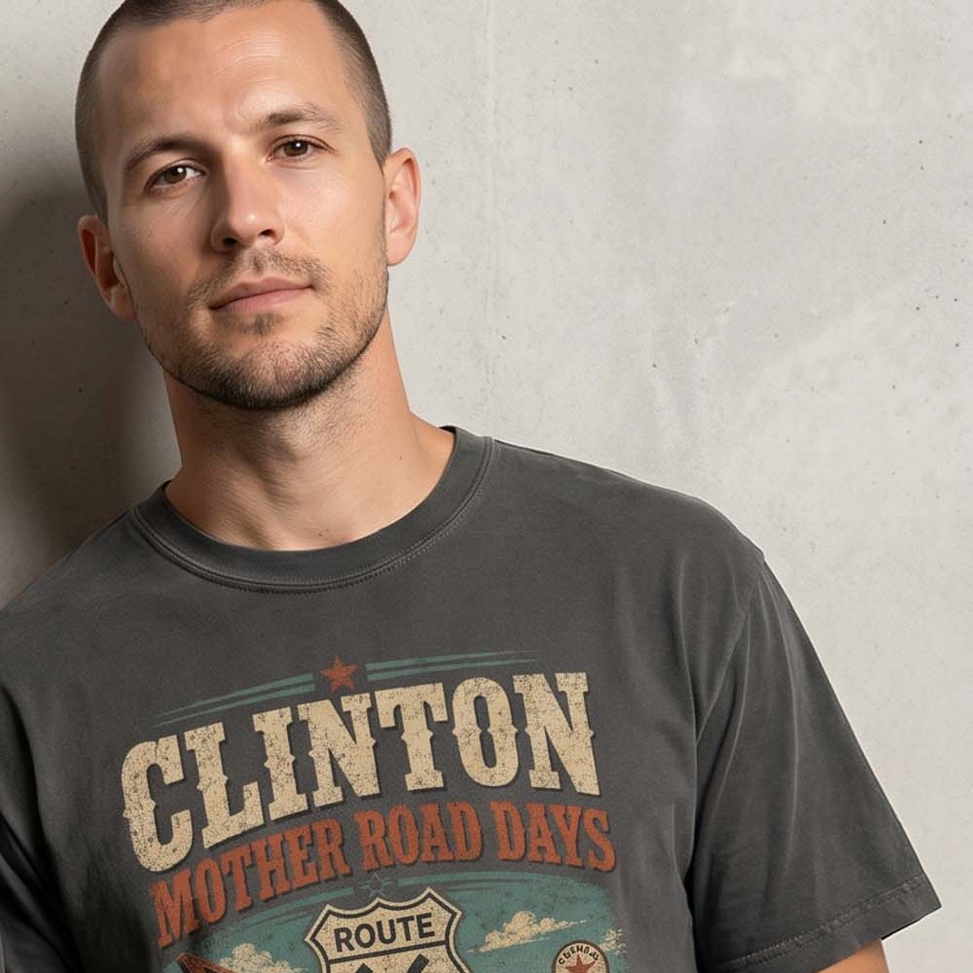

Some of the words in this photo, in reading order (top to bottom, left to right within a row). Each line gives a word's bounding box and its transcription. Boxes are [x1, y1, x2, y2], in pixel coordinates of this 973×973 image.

[121, 672, 601, 872] CLINTON
[150, 810, 352, 949] MOTHER
[355, 801, 484, 871] ROAD
[490, 801, 617, 872] DAYS
[333, 912, 437, 952] ROUTE
